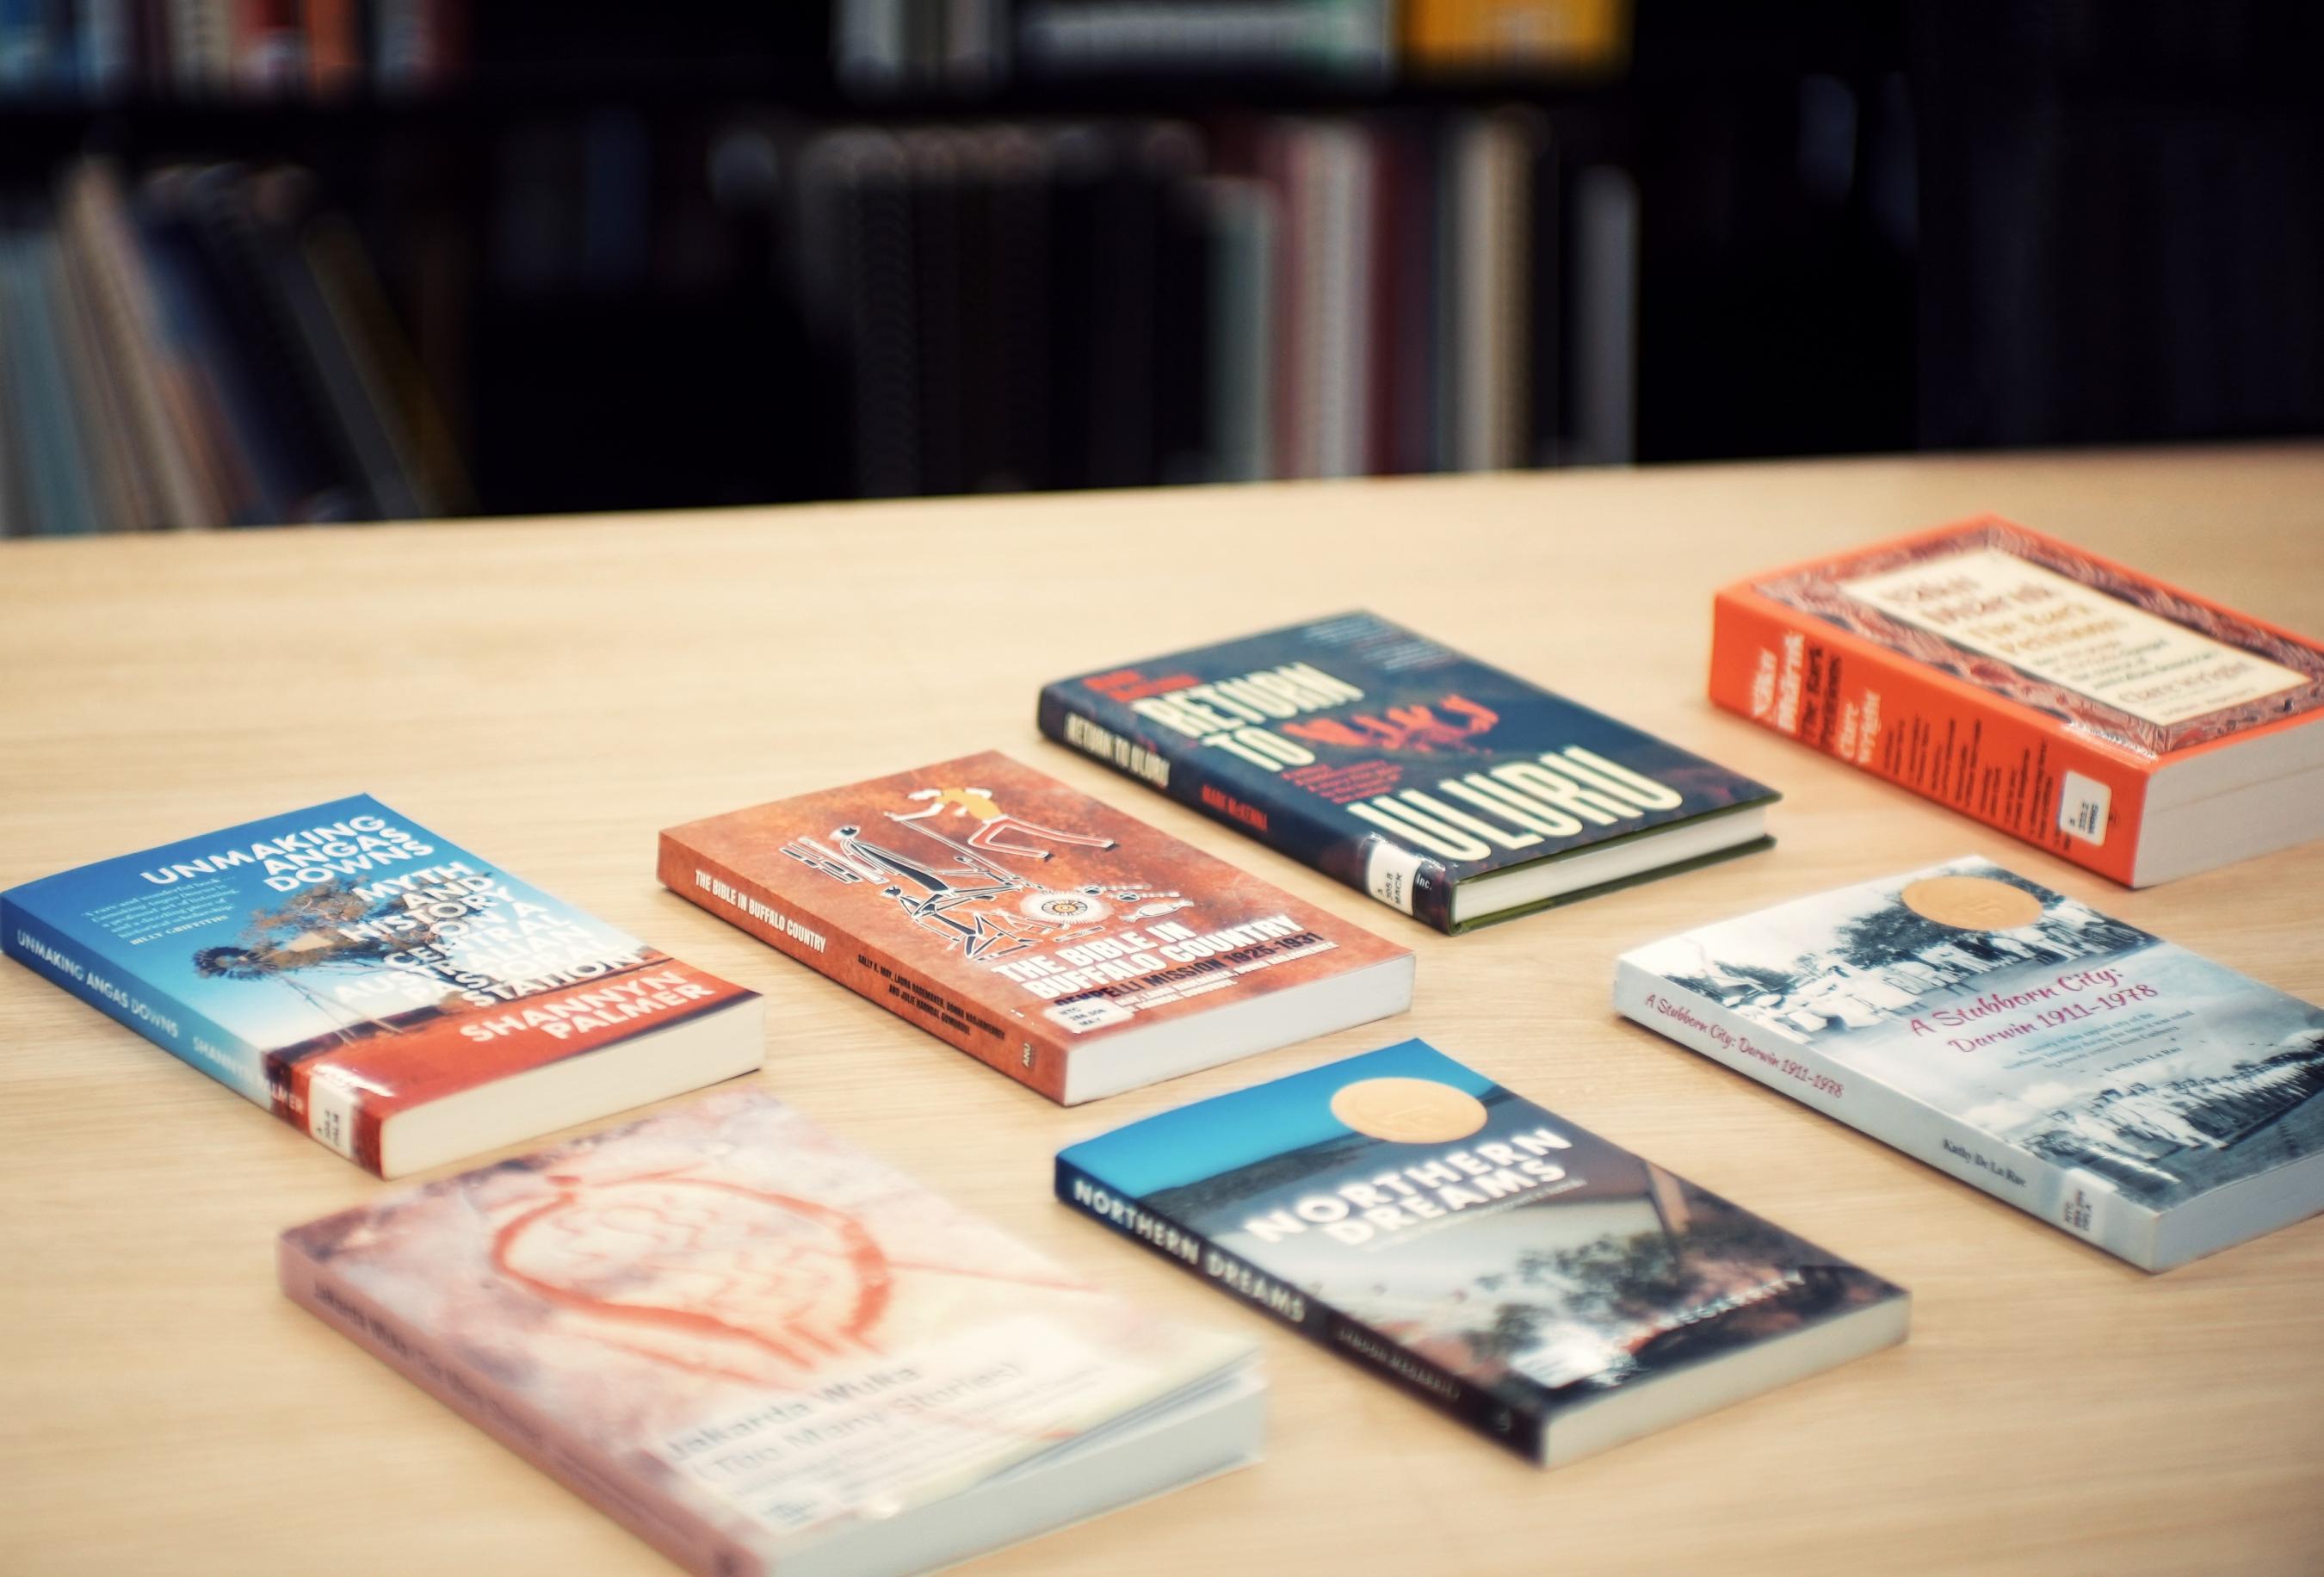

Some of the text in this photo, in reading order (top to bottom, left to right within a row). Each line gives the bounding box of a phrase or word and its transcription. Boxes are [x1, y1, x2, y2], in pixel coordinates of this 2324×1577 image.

[1130, 661, 1366, 740] RETURN
[1201, 726, 1316, 774] TO
[1347, 744, 1684, 862] ULURU
[139, 815, 386, 885] UNMAKING
[262, 840, 435, 893] DOWNS
[263, 826, 412, 876] ANGAS
[352, 862, 475, 901] MYTH
[403, 875, 495, 910] AND
[695, 869, 825, 954] THE BIBLE IN BUFFALO COUNTRY
[1416, 873, 1432, 891] Inc.
[339, 886, 516, 942] HISTORY
[384, 914, 572, 968] CENTRAL
[17, 929, 179, 1038] UNMAKING ANGAS DOWNS
[462, 951, 645, 1007] STATION
[990, 921, 1197, 984] THE BIBLE IN
[1022, 914, 1305, 999] BUFFALO COUNTRY
[1141, 959, 1227, 988] MISSION
[1224, 932, 1325, 964] 1925-1931
[460, 971, 688, 1042] SHANNYN
[540, 983, 715, 1040] PALMER
[1645, 993, 1655, 1009] A
[1658, 998, 1709, 1034] Stubborn
[1710, 1024, 1736, 1049] City:
[1738, 1036, 1780, 1068] Darwin
[1910, 968, 2123, 1036] A Stubborn City:
[1947, 984, 2160, 1053] Darwin 1911-1978
[1023, 1042, 1031, 1067] ANU
[1943, 1138, 1971, 1164] Kathy
[1244, 1128, 1573, 1243] NORTHERN
[1321, 1159, 1567, 1246] DREAMS
[1073, 1179, 1307, 1323] NORTHERN DREAMS
